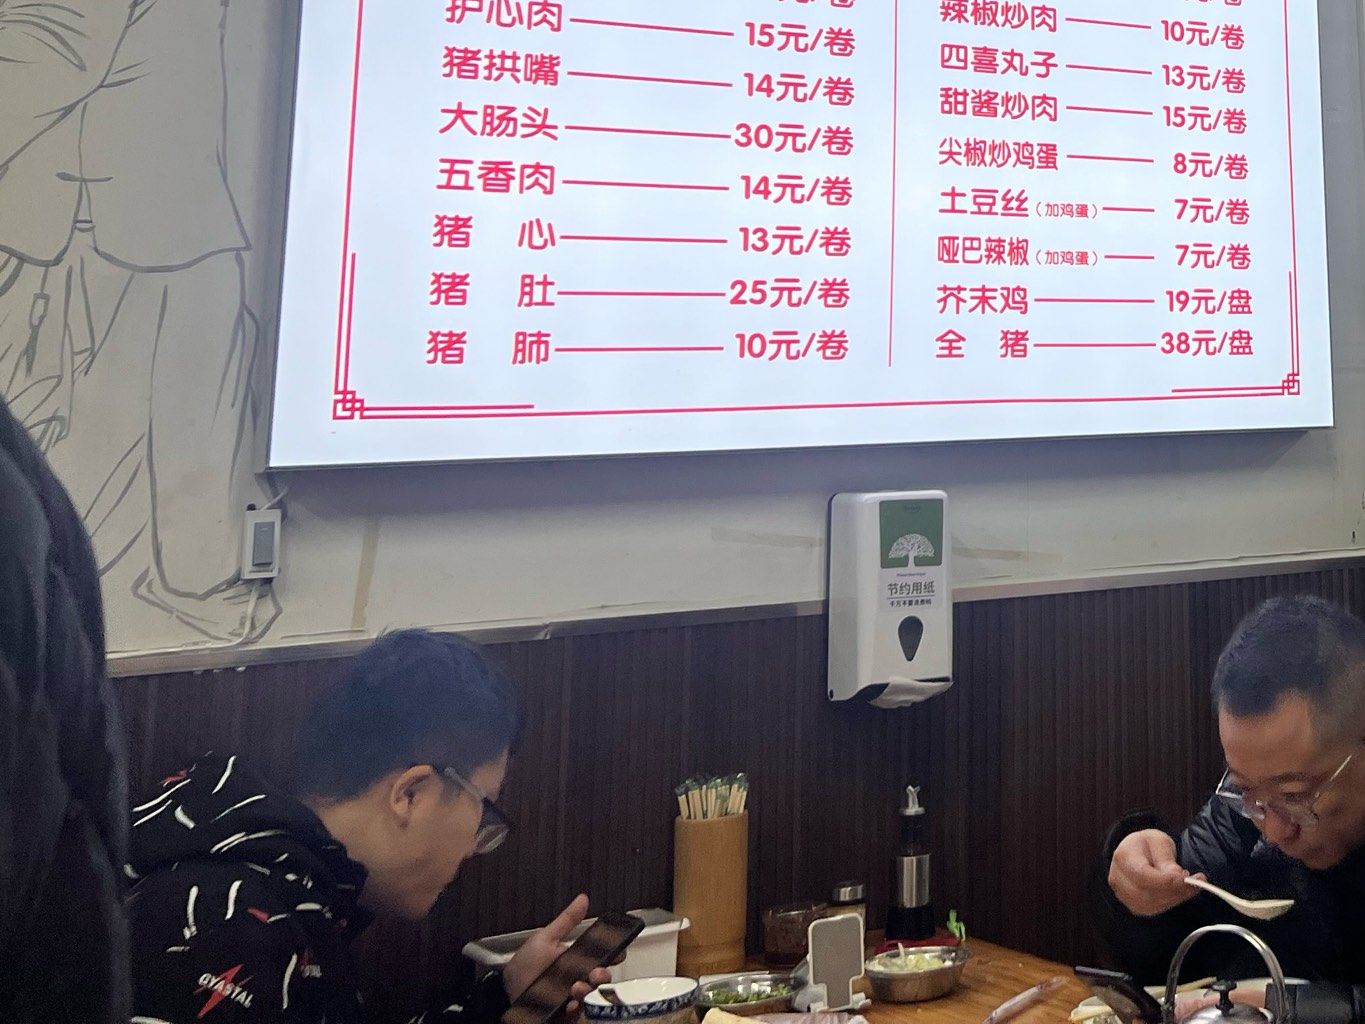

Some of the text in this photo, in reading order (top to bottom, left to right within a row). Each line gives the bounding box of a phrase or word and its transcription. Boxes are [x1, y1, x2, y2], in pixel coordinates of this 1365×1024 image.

[746, 21, 854, 57] 15元/卷
[1162, 19, 1244, 50] 10元/卷
[442, 46, 853, 106] 猪拱嘴 14元/卷
[940, 43, 1246, 94] 四喜丸子 13元/卷
[439, 100, 853, 156] 大肠头 30元/卷
[940, 86, 1246, 135] 甜酱炒肉 15元/卷
[940, 138, 1248, 180] 尖椒炒鸡蛋 8元/卷
[436, 157, 852, 207] 五香肉 14元/卷
[939, 187, 1028, 218] 土豆丝
[1174, 197, 1249, 225] 7元/卷
[739, 225, 850, 257] 13元/卷
[937, 235, 1029, 265] 哑巴辣椒
[1175, 243, 1251, 270] 7元/卷
[729, 277, 849, 309] 25元/卷
[937, 284, 1252, 316] 芥末鸡 19元/盘
[735, 329, 849, 361] 10元/卷
[1160, 328, 1253, 357] 38元/盘
[887, 582, 935, 596] 节约用纸
